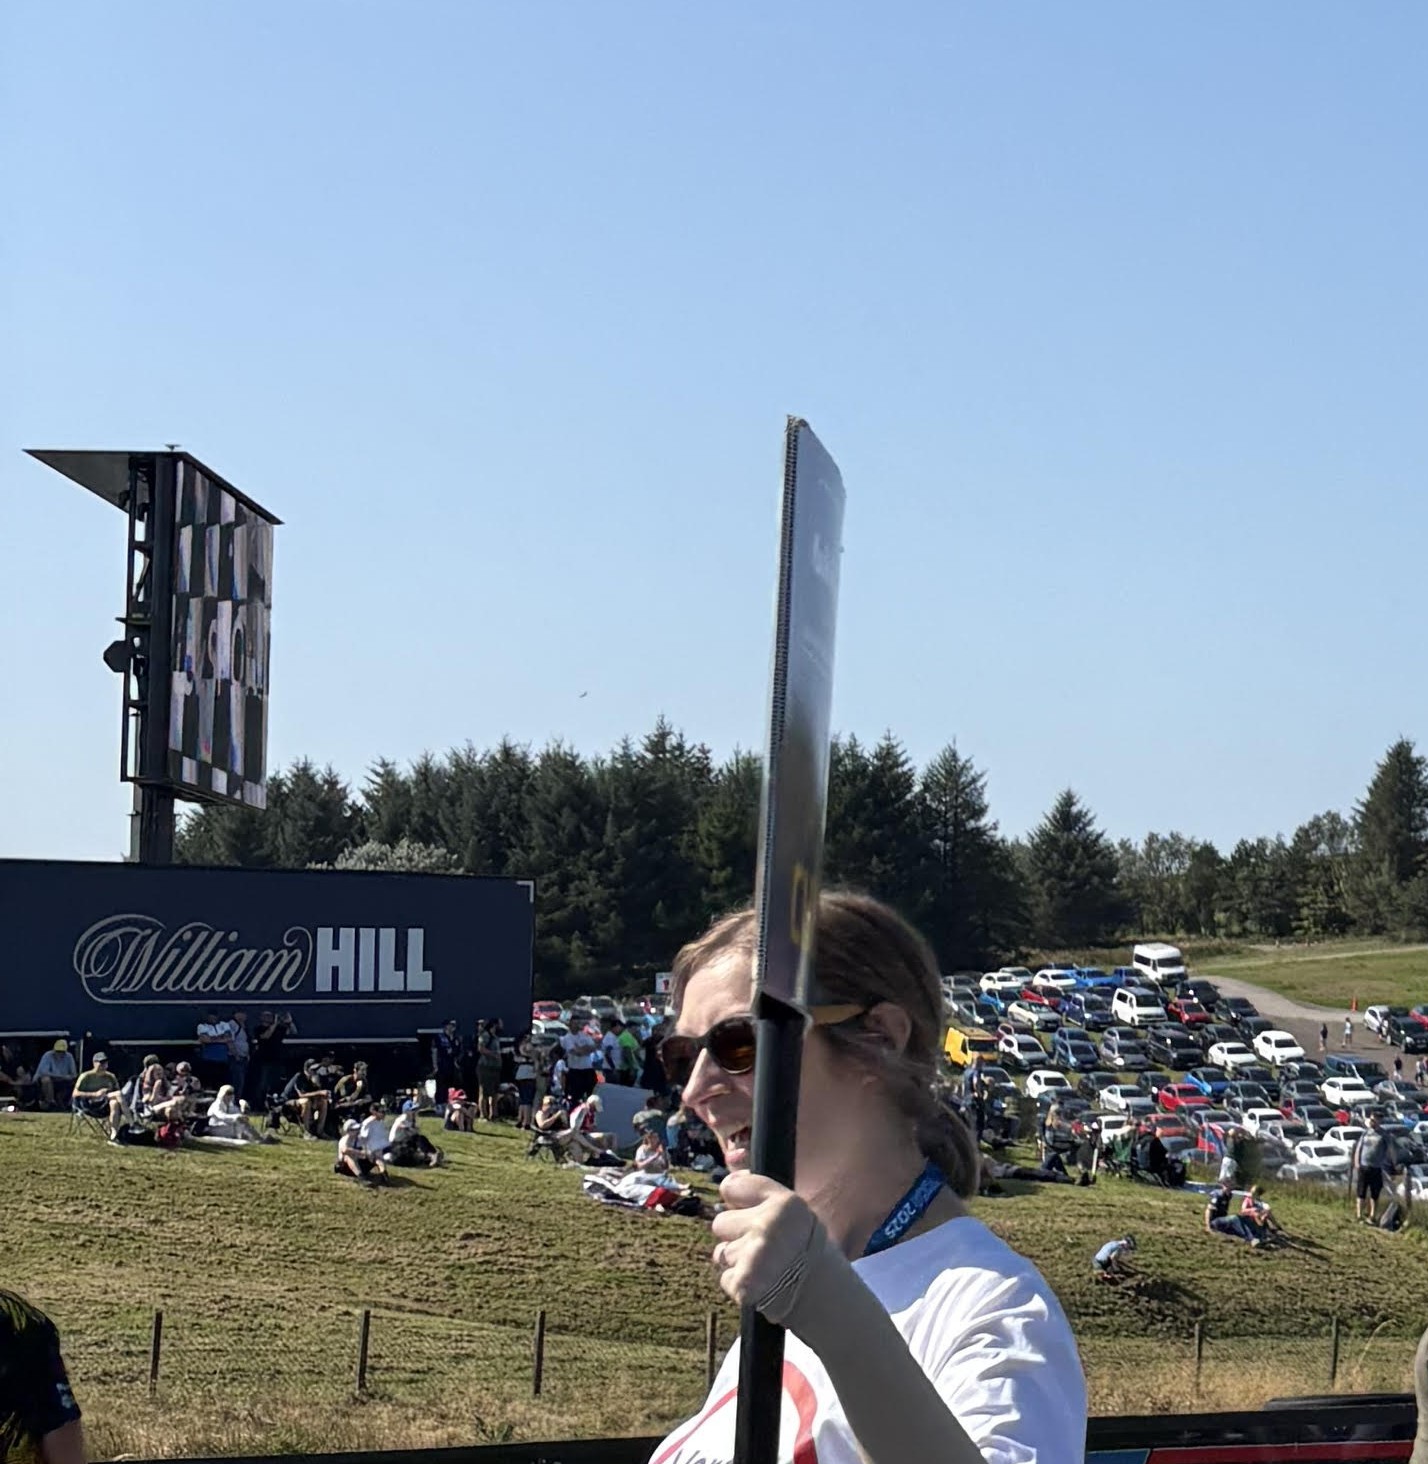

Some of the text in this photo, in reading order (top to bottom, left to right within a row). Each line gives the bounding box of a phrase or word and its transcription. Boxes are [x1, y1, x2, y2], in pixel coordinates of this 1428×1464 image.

[73, 914, 432, 1003] William HILL
[884, 1201, 917, 1239] 2025
